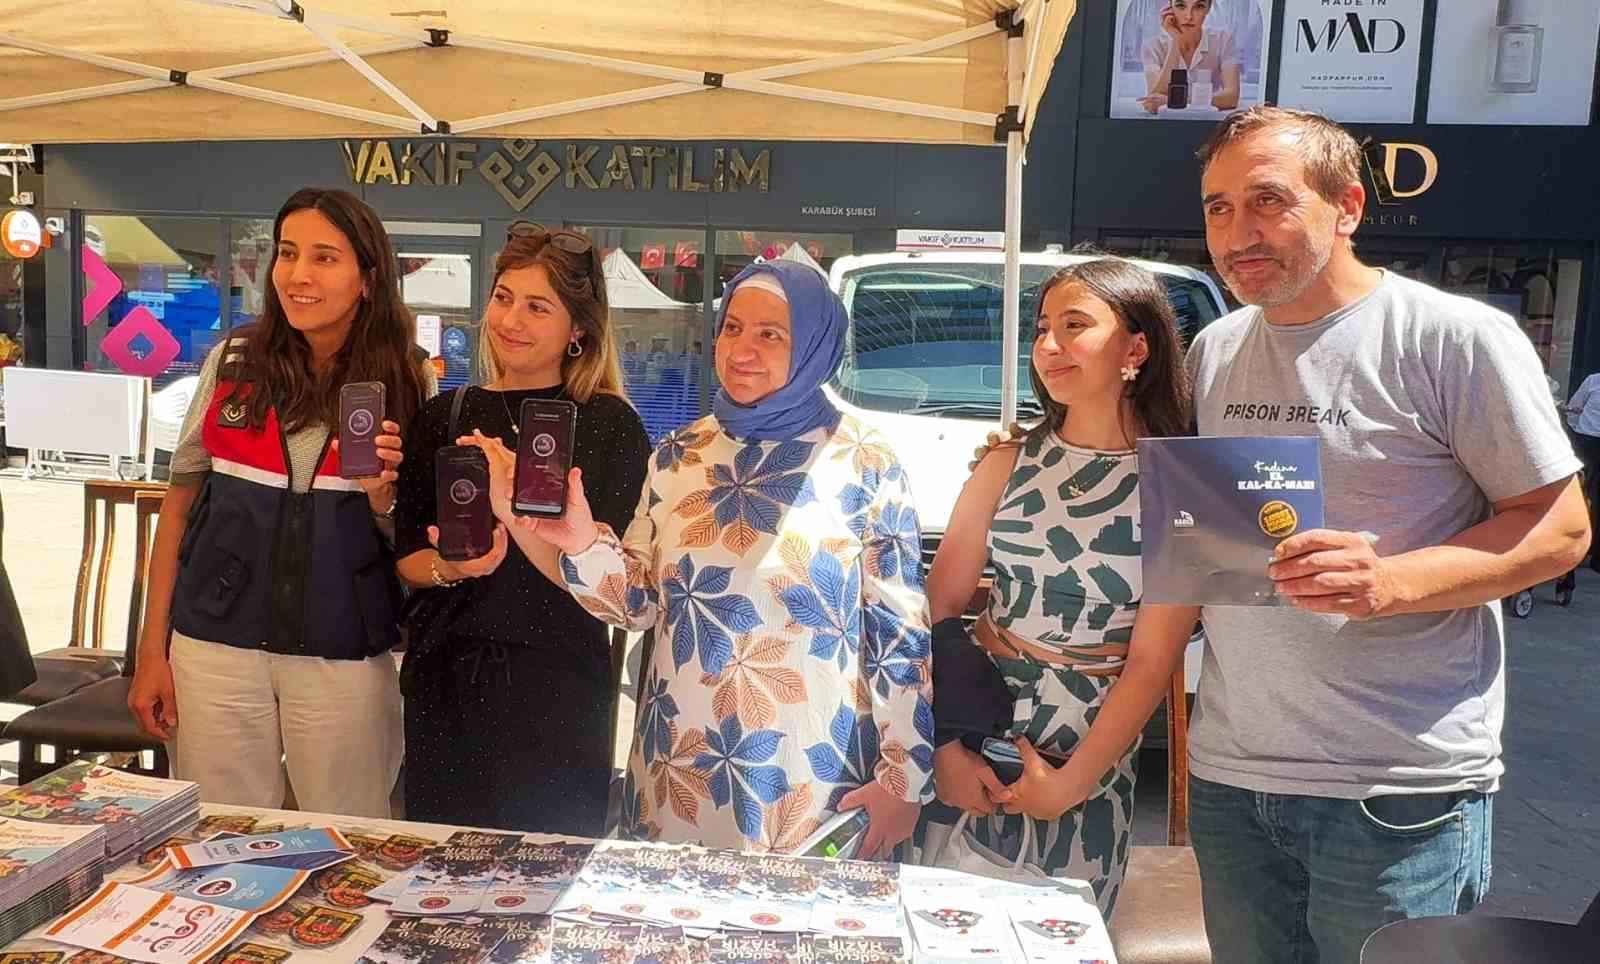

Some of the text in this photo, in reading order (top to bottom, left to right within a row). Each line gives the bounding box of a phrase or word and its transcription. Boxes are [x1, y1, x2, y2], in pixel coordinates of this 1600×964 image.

[1295, 12, 1406, 54] MAD
[338, 140, 770, 193] VAKIF KATILIM
[1223, 403, 1352, 427] PRISON BREAK
